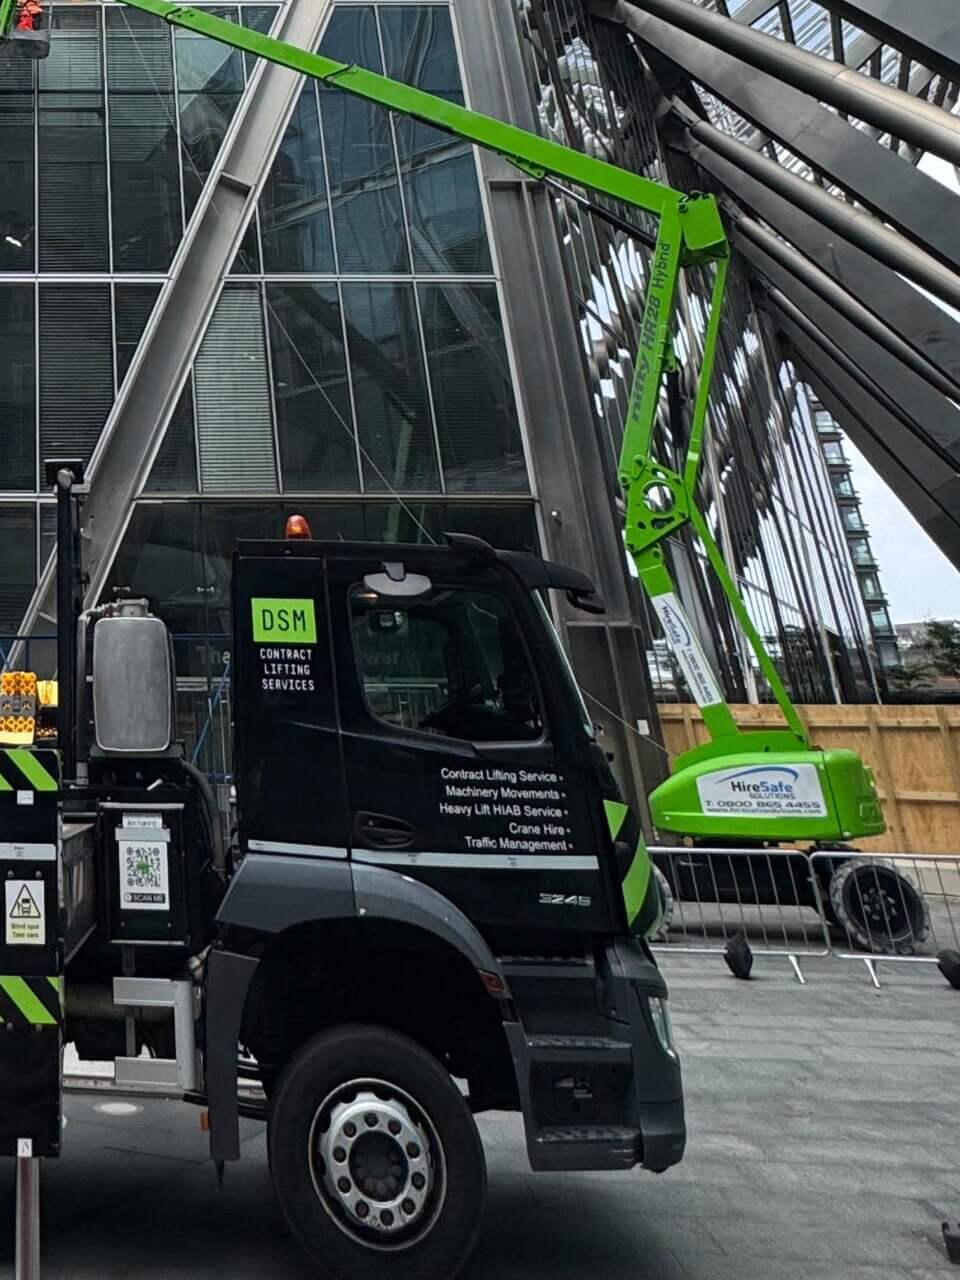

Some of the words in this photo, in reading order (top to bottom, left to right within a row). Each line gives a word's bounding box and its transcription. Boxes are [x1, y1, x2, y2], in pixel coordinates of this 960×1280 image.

[651, 243, 671, 289] Hybrid
[261, 609, 306, 632] DSM
[260, 648, 312, 660] CONTRACT
[264, 663, 311, 675] LIFTING
[261, 678, 315, 691] SERVICES
[441, 768, 484, 781] Contract
[486, 769, 517, 783] Lifting
[519, 770, 557, 782] Service
[446, 785, 498, 800] Machinery
[500, 787, 560, 800] Movements
[730, 781, 793, 793] HireSafe
[439, 802, 472, 816] Heavy
[474, 803, 491, 816] Lift
[493, 805, 521, 816] HIAB
[524, 805, 562, 818] Service
[717, 800, 752, 808] 0800
[509, 822, 540, 835] Crane
[543, 824, 565, 835] Hire
[464, 836, 497, 849] Traffic
[499, 838, 567, 852] Management
